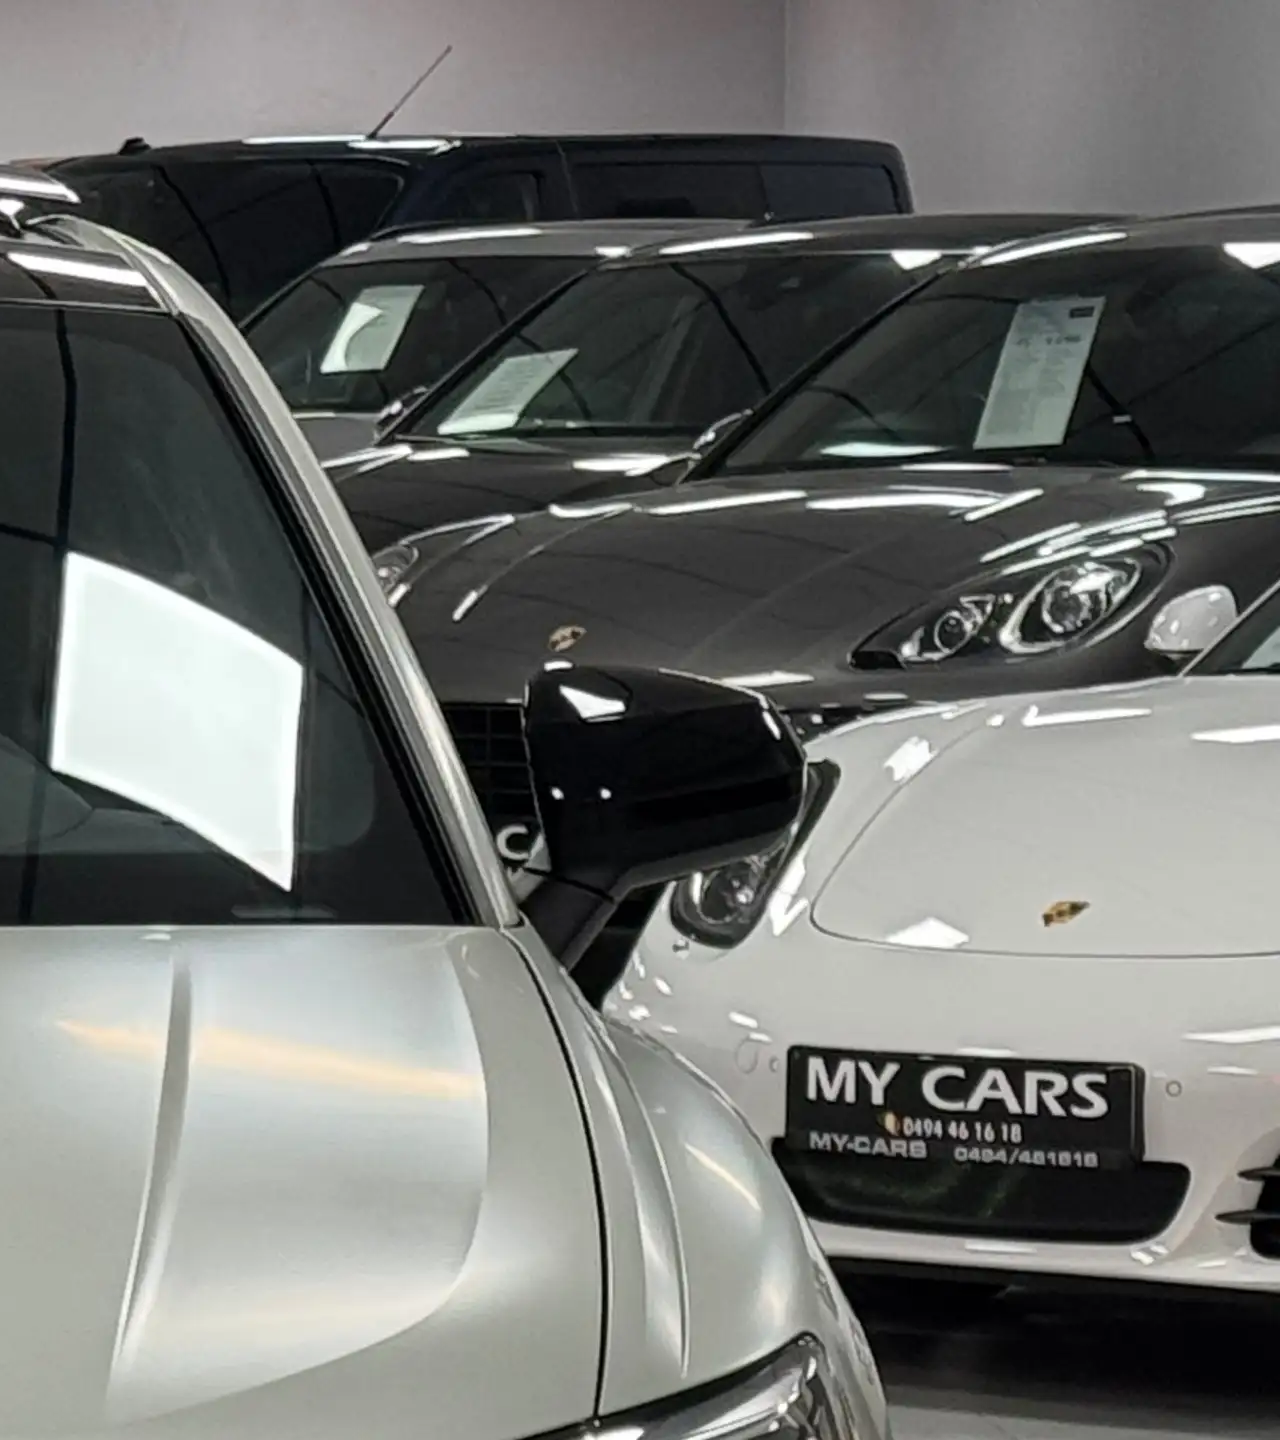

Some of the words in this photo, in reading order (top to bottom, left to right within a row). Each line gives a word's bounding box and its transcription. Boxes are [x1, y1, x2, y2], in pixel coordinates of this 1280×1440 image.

[806, 1056, 900, 1106] MY
[921, 1065, 1109, 1119] CARS
[904, 1117, 942, 1138] 0494
[948, 1120, 969, 1140] 46
[975, 1121, 995, 1142] 16
[1001, 1122, 1022, 1143] 18
[809, 1131, 928, 1158] MY-CARS
